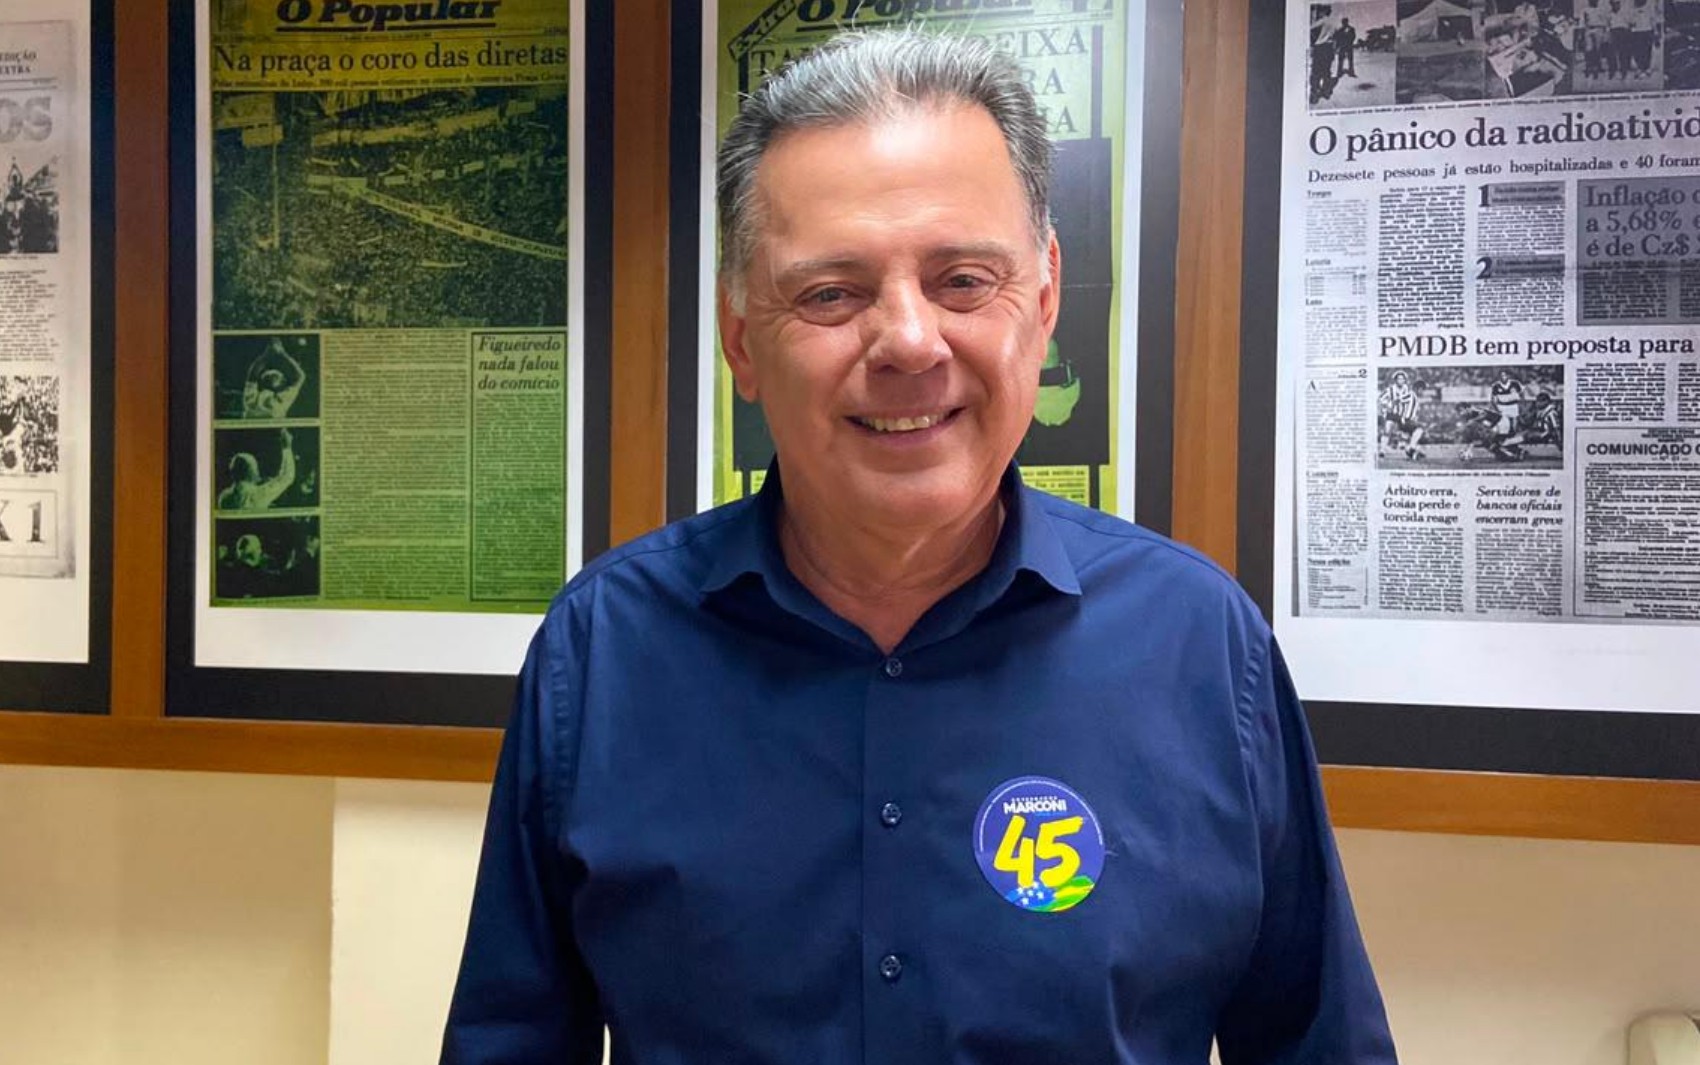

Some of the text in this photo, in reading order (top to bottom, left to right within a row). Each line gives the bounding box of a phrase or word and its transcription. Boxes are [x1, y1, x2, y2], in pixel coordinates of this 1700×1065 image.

[277, 0, 501, 31] O Popular
[968, 27, 1088, 59] EIXA
[213, 40, 567, 77] Na praça o coro das diretas
[1309, 126, 1338, 155] O
[1346, 121, 1457, 161] pânico
[1465, 116, 1508, 147] da
[1307, 169, 1375, 182] Dezessete
[1383, 167, 1435, 182] pessoas
[1442, 163, 1457, 179] já
[1465, 163, 1502, 175] estão
[1510, 157, 1613, 175] hospitalizadas
[1619, 160, 1629, 168] e
[1635, 154, 1653, 169] 40
[1478, 184, 1491, 207] 1
[1584, 184, 1686, 209] Inflação
[1586, 217, 1599, 233] a
[1606, 209, 1682, 235] 5,68%
[1586, 233, 1690, 257] é de Cz$
[1476, 256, 1493, 279] 2
[479, 335, 561, 355] Figueiredo
[1380, 335, 1695, 360] PMDB tem proposta para
[478, 355, 559, 374] nada falou
[478, 374, 497, 390] do
[1586, 443, 1692, 456] COMUNICADO
[1476, 485, 1562, 497] Servidores de
[1418, 500, 1453, 512] perde
[1476, 498, 1562, 513] bancos oficiais
[26, 499, 46, 544] 1
[1384, 511, 1458, 525] torcida reage
[1475, 515, 1563, 527] encerram greve
[1003, 799, 1067, 814] MARCONI
[993, 815, 1083, 888] 45
